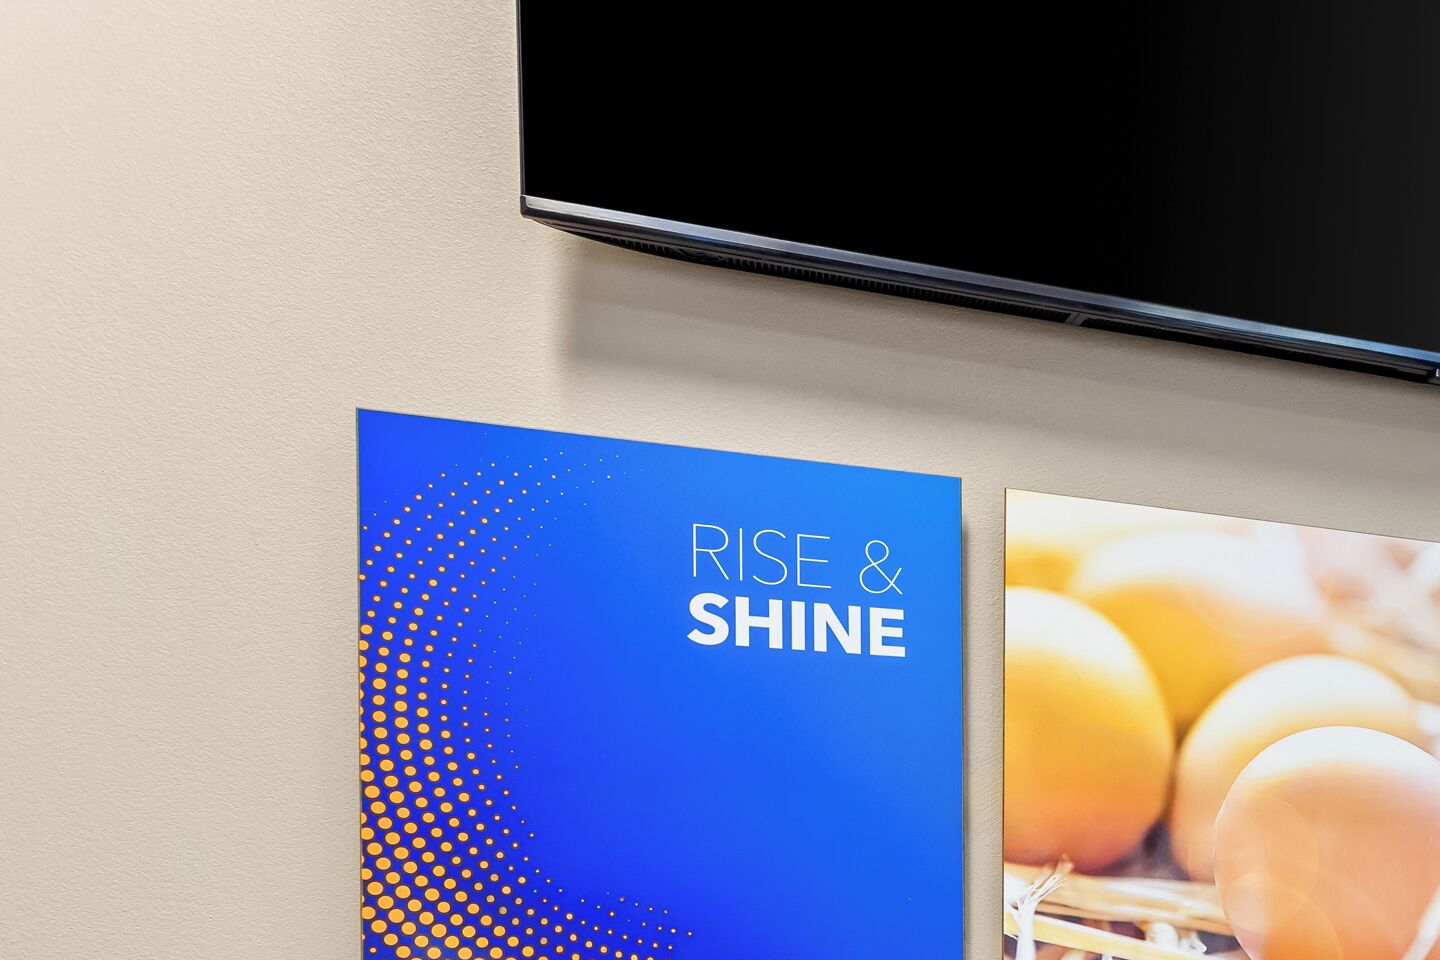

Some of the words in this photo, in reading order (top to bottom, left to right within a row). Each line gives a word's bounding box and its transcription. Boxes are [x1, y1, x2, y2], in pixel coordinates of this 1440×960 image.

[692, 523, 832, 589] RISE
[859, 539, 903, 595] &
[686, 592, 906, 658] SHINE
